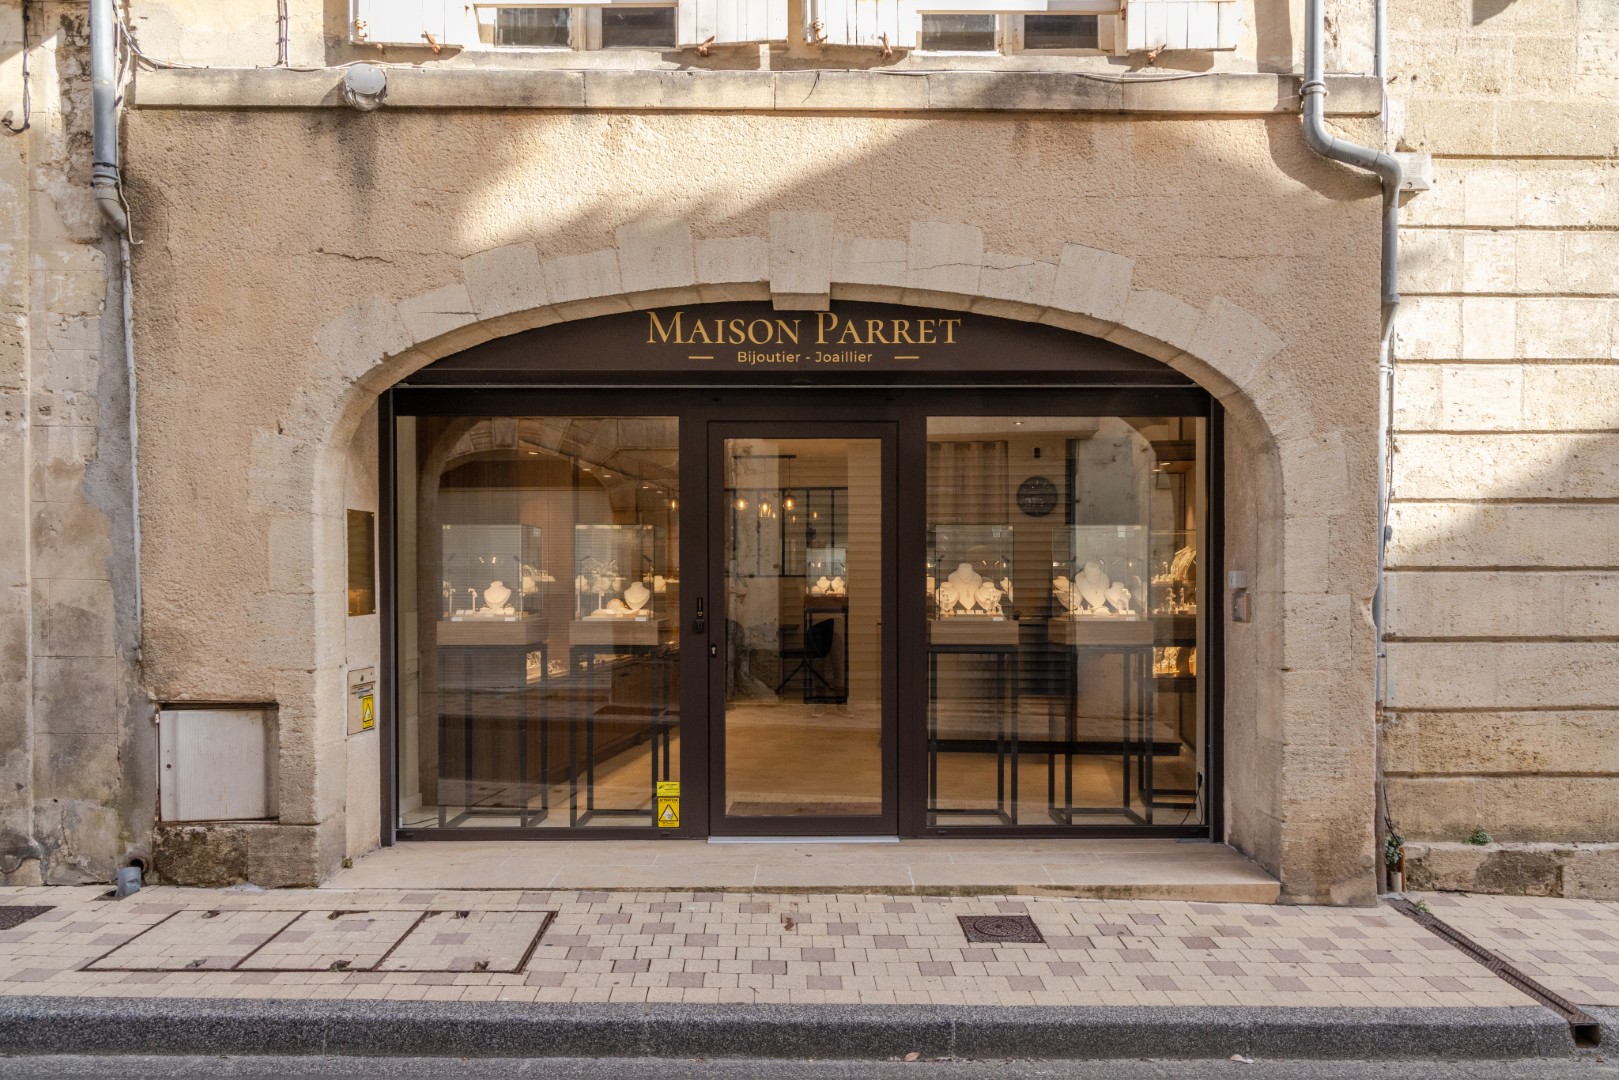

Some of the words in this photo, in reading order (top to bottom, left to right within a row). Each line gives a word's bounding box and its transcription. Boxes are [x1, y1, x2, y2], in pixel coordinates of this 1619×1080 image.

[646, 311, 801, 345] MAISON
[815, 312, 962, 345] PARRET
[737, 351, 801, 365] Bijoutier
[815, 351, 873, 364] Joaillier
